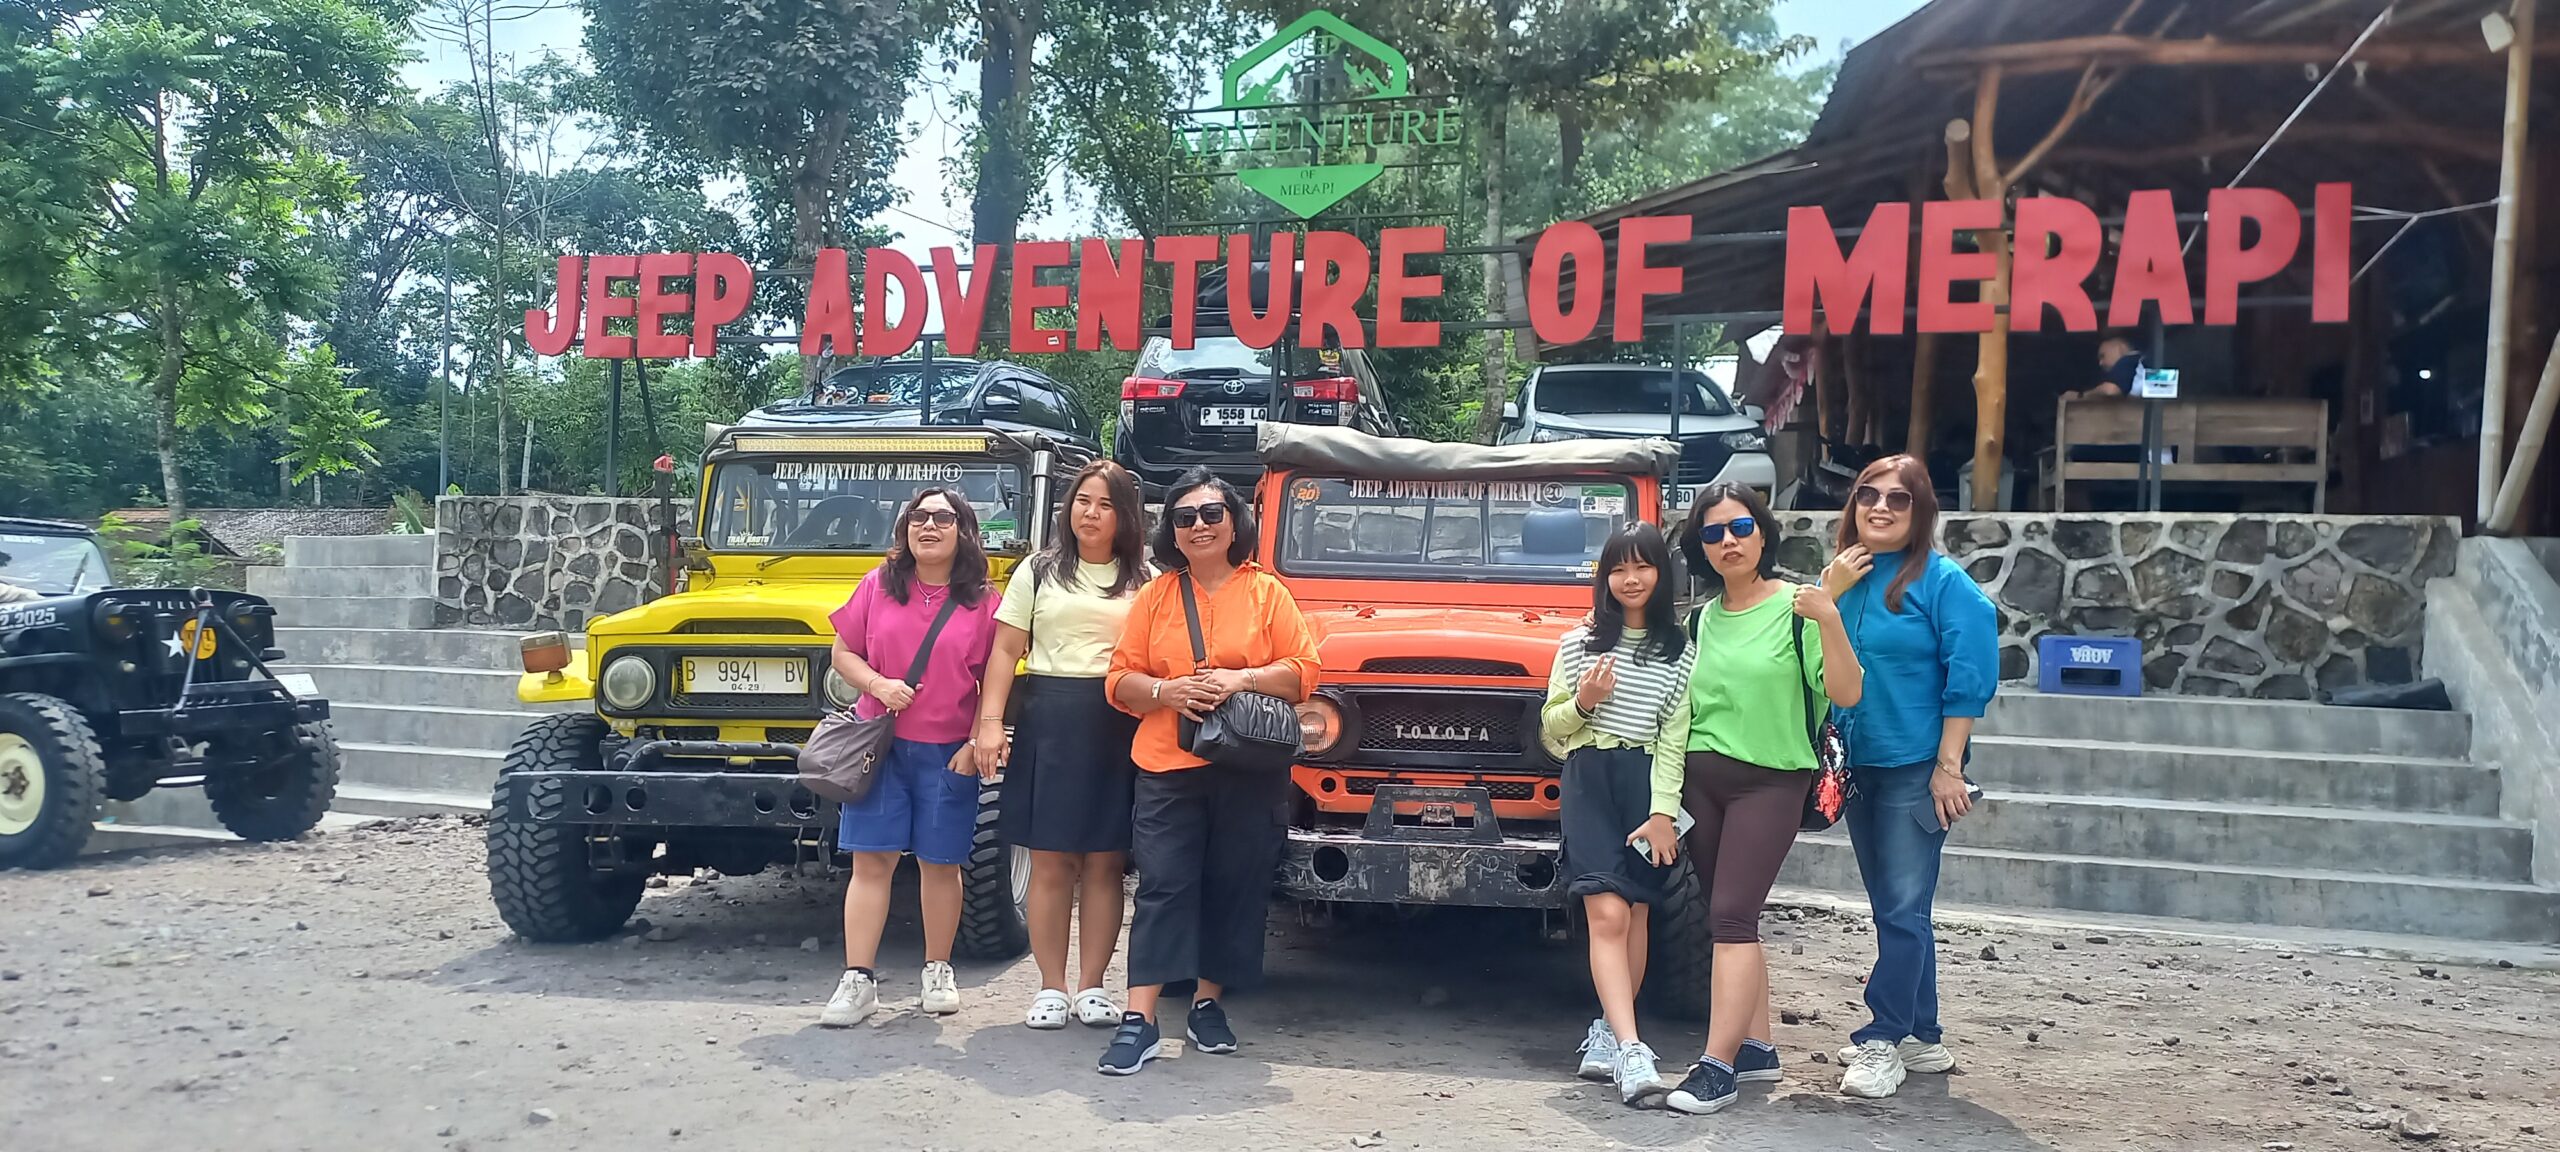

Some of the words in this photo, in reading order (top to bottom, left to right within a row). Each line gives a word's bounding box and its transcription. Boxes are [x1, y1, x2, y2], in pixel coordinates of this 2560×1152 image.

[1165, 107, 1463, 159] ADVENTURE
[1300, 169, 1316, 180] OF
[1279, 182, 1336, 196] MERAPI
[525, 253, 754, 360] JEEP
[800, 226, 1447, 357] ADVENTURE
[1528, 214, 1693, 345] OF
[1783, 181, 2353, 336] MERAPI
[1203, 408, 1211, 420] P
[1216, 408, 1245, 420] 1558
[773, 462, 803, 480] JEEP
[805, 463, 876, 481] ADVENTURE
[878, 464, 894, 481] OF
[895, 464, 943, 482] MERAPI
[1296, 487, 1316, 500] 20
[1349, 480, 1382, 498] JEEP
[1385, 480, 1465, 499] ADVENTURE
[1468, 482, 1486, 501] OF
[1488, 482, 1542, 502] MERAPI
[685, 660, 696, 682] B
[718, 660, 758, 682] 9941
[785, 661, 807, 683] BV
[1395, 725, 1489, 741] TOYOTA
